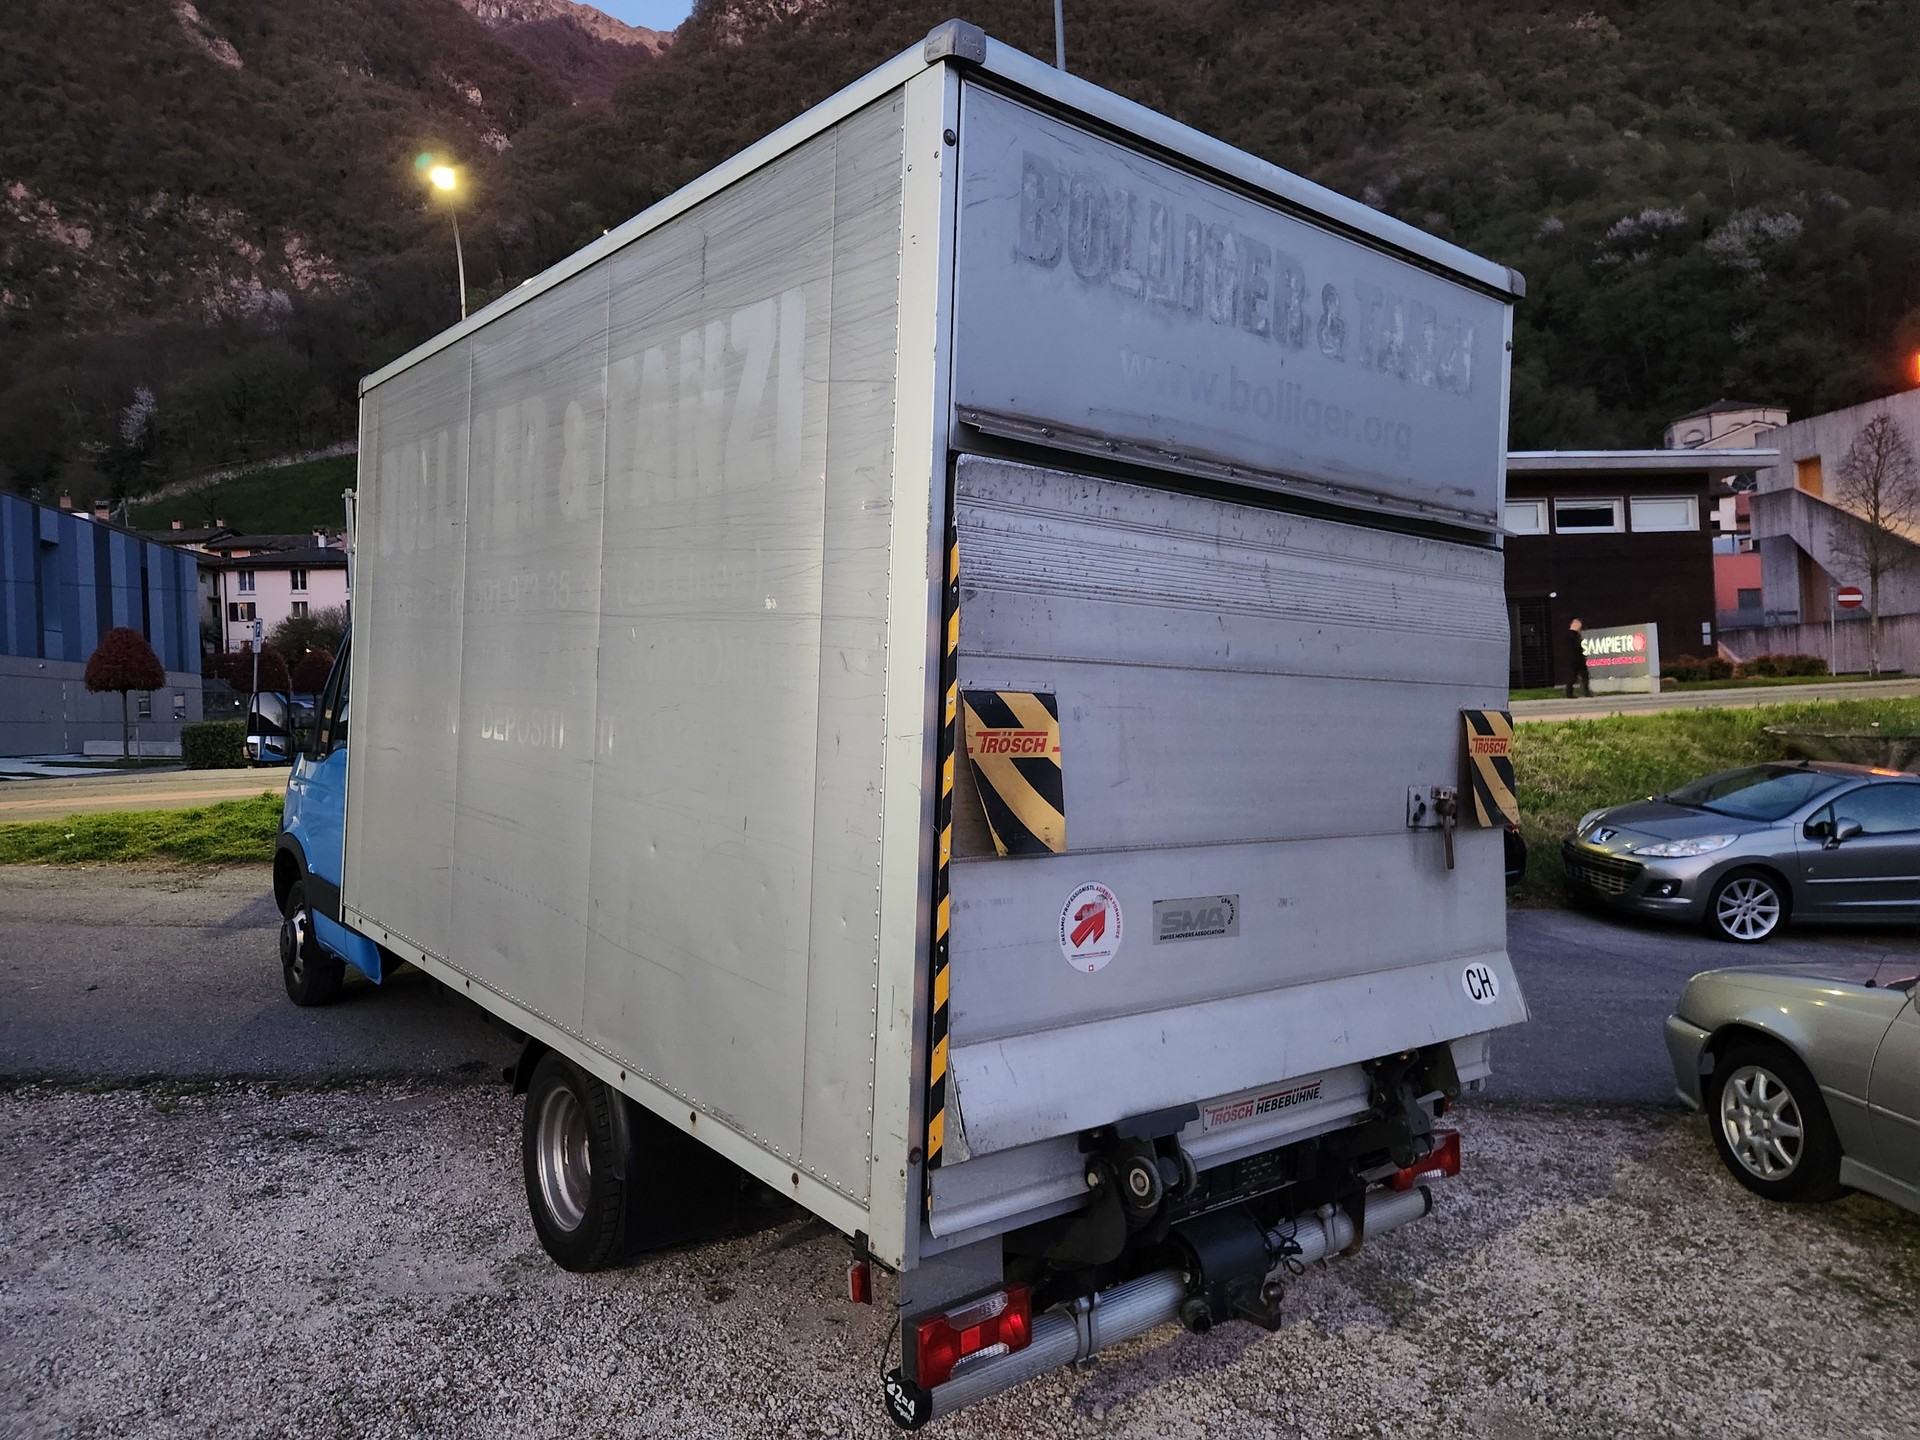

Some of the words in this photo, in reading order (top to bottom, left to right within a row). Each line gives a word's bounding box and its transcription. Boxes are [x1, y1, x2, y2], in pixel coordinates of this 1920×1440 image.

[975, 731, 1048, 754] TRÖSCH
[1472, 737, 1508, 753] TRÖSCH
[1161, 907, 1225, 933] SMA
[1160, 933, 1174, 941] SWISS
[1466, 966, 1495, 1000] CH
[1207, 1100, 1254, 1126] TRÖSCH
